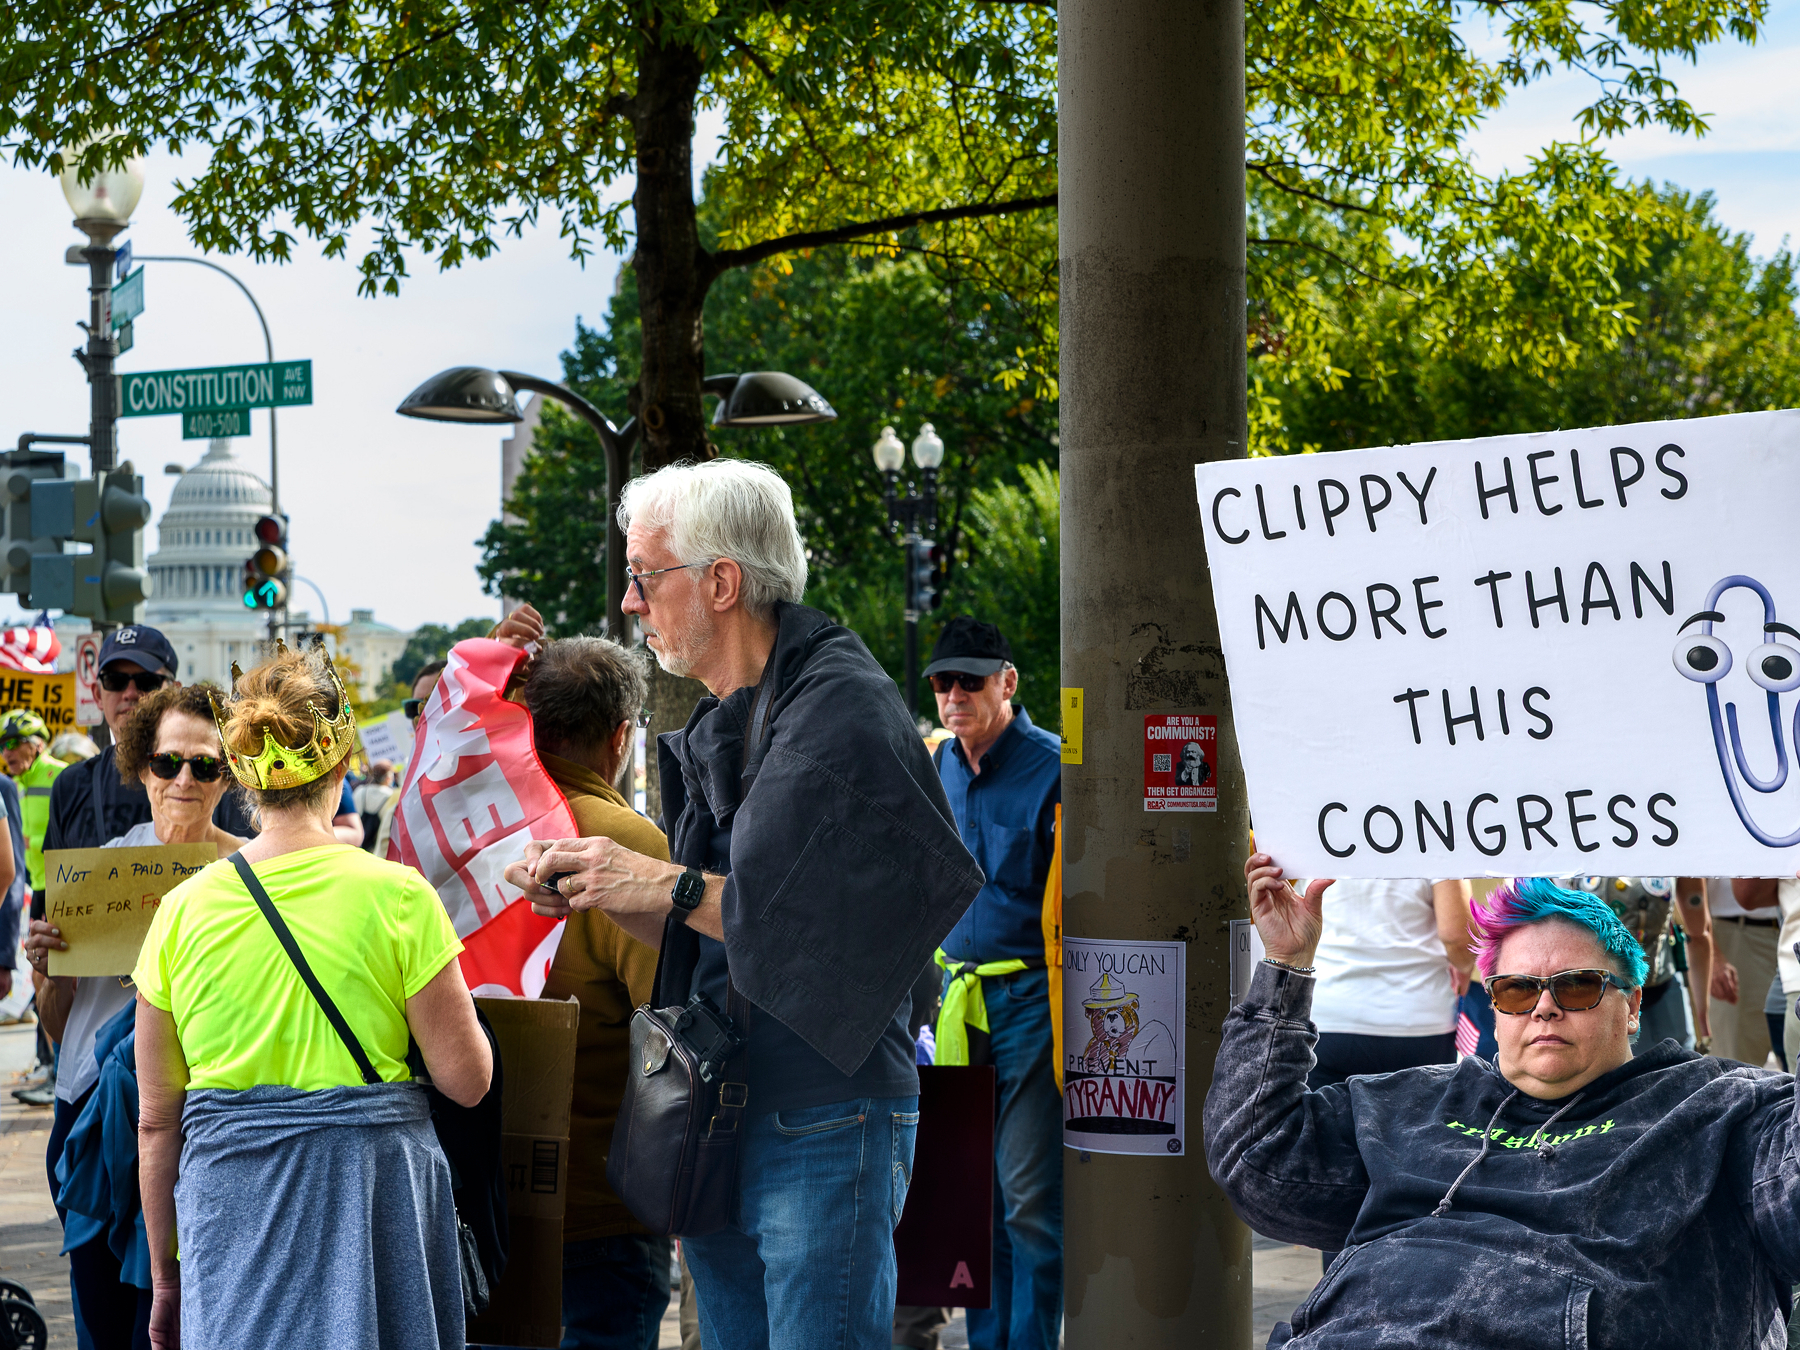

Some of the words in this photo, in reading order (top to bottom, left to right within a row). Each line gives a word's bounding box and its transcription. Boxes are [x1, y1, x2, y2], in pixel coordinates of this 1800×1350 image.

[129, 369, 274, 412] CONSTITUTION
[284, 366, 303, 382] AVE
[283, 385, 306, 399] NW
[189, 412, 240, 436] 400-500
[1212, 466, 1437, 545] CLIPPY
[1474, 443, 1688, 520] HELPS
[1254, 575, 1447, 650] MORE
[1474, 560, 1674, 629] THAN
[43, 684, 63, 704] IS
[1166, 716, 1180, 726] ARE
[1181, 716, 1194, 726] YOU
[1194, 716, 1200, 726] A
[1393, 686, 1553, 746] THIS
[1147, 726, 1216, 740] COMMUNIST?
[1147, 786, 1165, 796] THEN
[1166, 786, 1179, 796] GET
[1180, 786, 1216, 796] ORGANIZED!
[1317, 789, 1679, 858] CONGRESS
[56, 864, 92, 884] NOT
[108, 867, 119, 880] A
[51, 900, 95, 919] HERE
[106, 899, 132, 914] FOR
[1066, 949, 1090, 973] ONLY
[1069, 1053, 1158, 1077] PREVENT
[1066, 1077, 1176, 1122] TYRANNY
[949, 1261, 974, 1288] A
